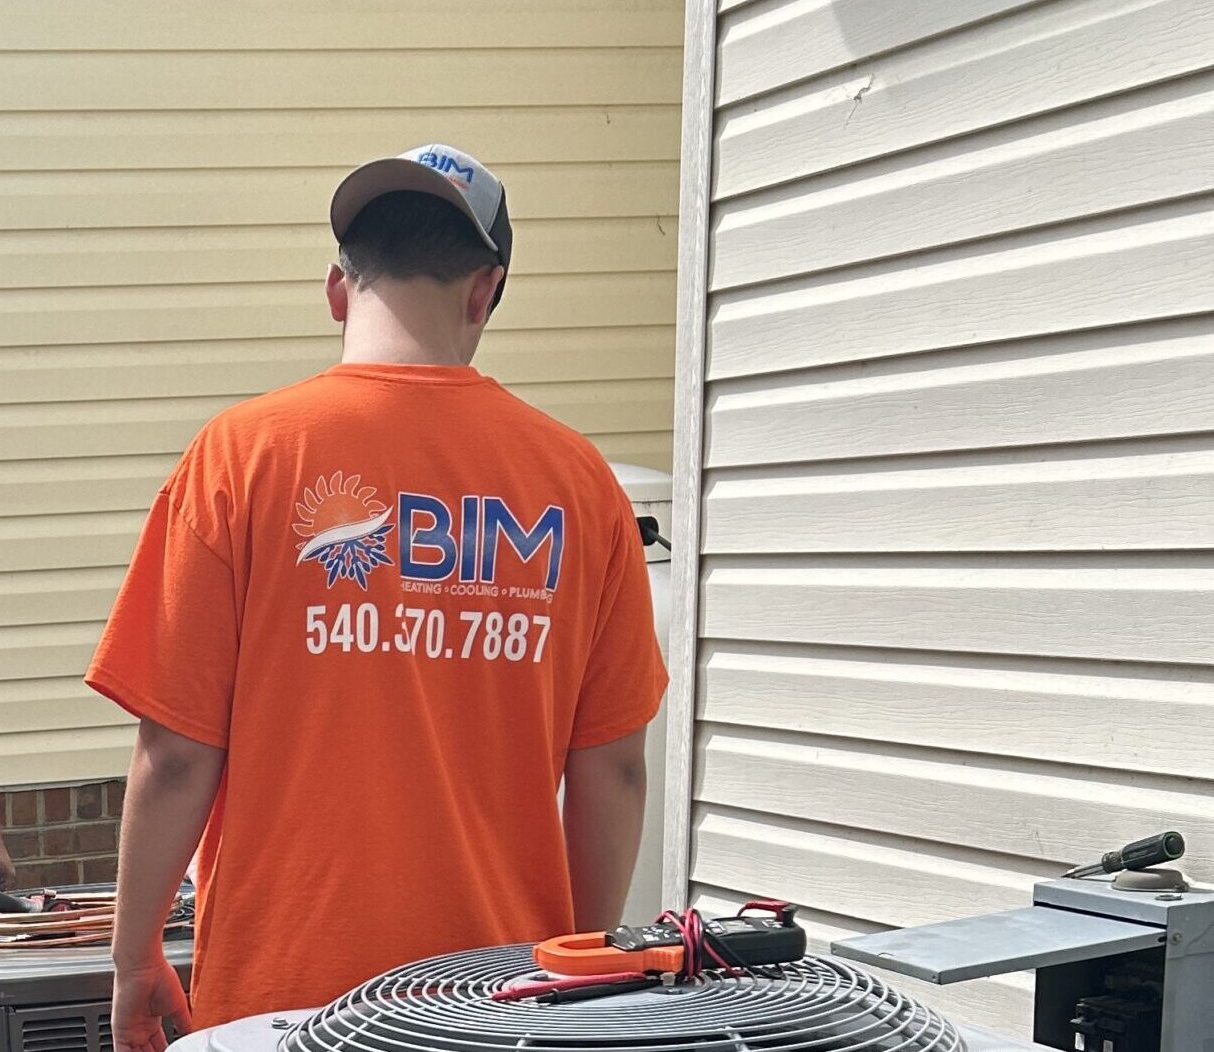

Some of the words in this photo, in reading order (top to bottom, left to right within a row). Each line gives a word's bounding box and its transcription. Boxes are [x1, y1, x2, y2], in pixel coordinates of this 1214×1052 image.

[419, 152, 474, 184] BIM
[398, 491, 565, 593] BIM
[450, 584, 499, 597] COOLING
[508, 587, 554, 604] PLUMBG
[305, 602, 552, 663] 540.370.7887
